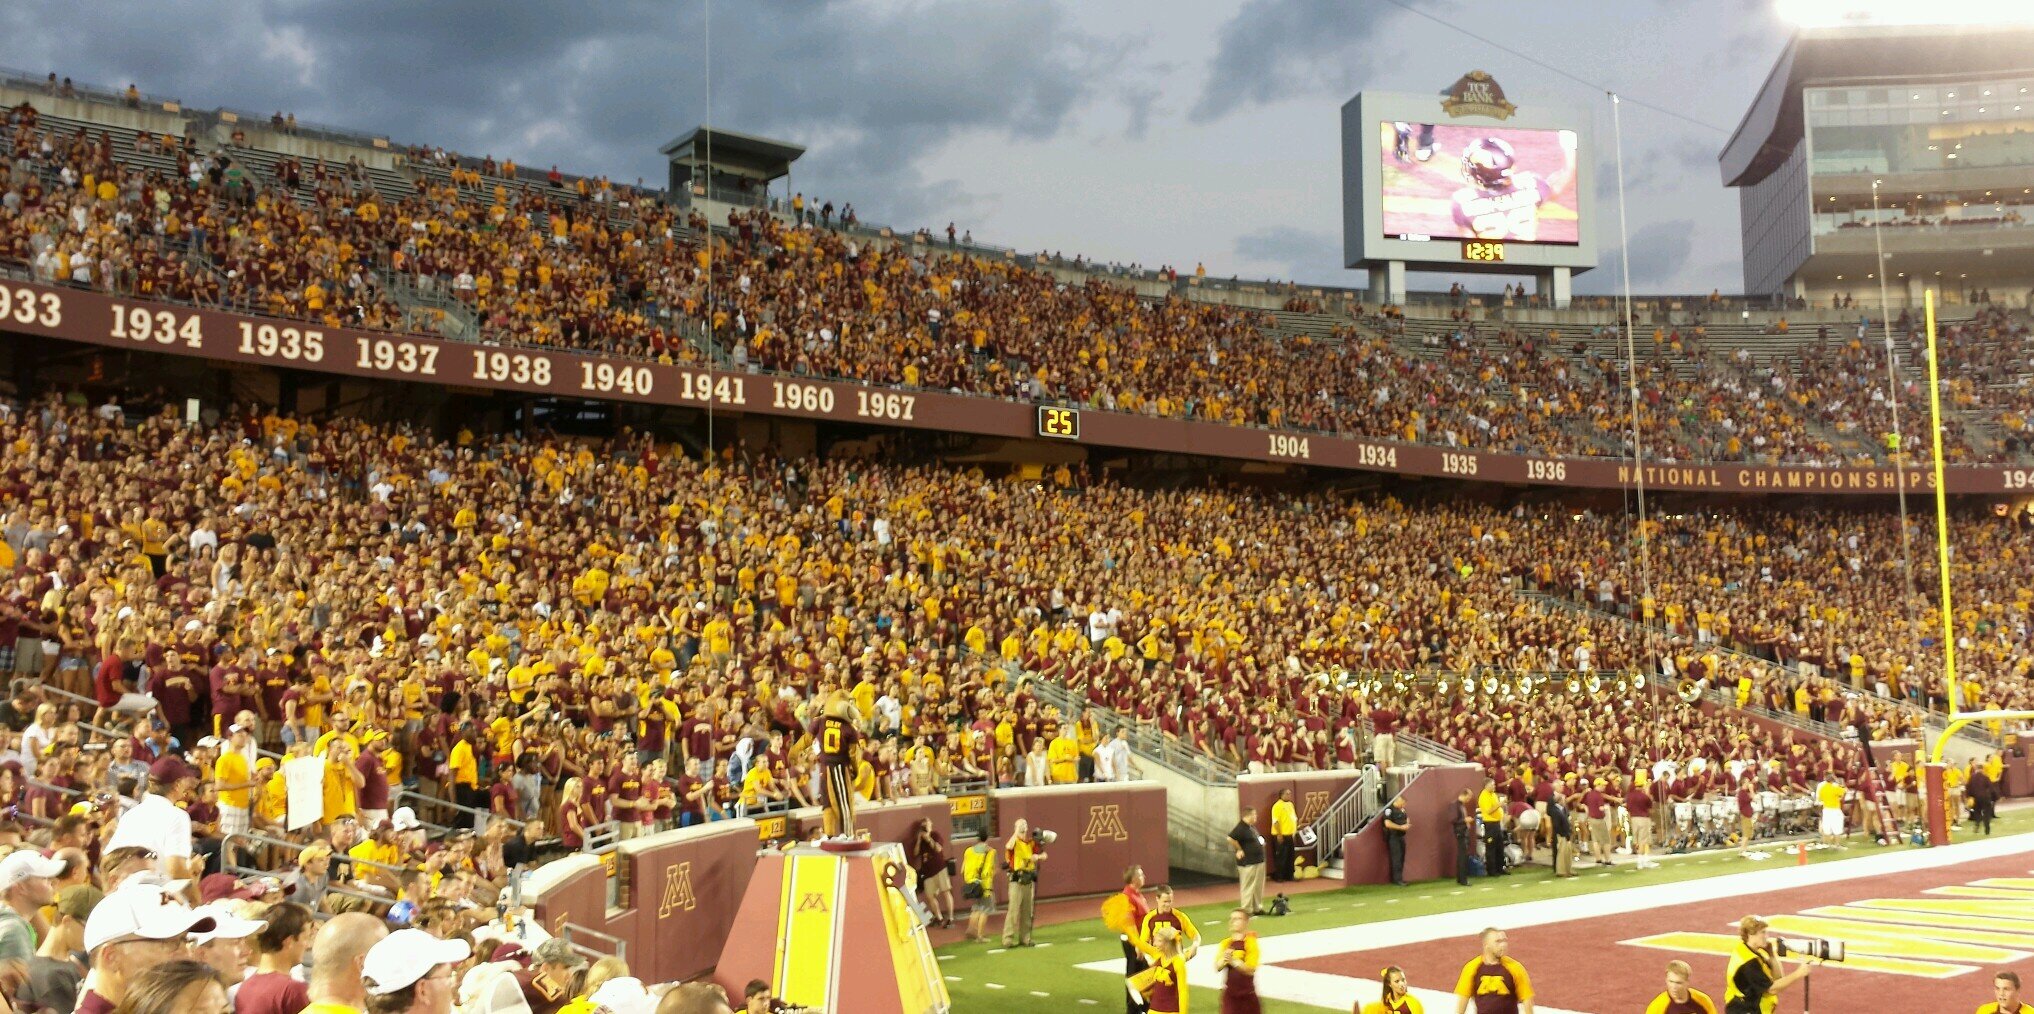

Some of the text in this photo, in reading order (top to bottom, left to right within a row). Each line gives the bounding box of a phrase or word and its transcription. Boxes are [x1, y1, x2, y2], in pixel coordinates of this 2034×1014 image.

[1463, 91, 1494, 104] BANK
[1466, 242, 1504, 261] 12:39
[110, 304, 203, 349] 1934
[238, 321, 324, 362] 1935
[356, 337, 440, 375] 1937
[473, 350, 552, 386] 1938
[581, 361, 654, 396] 1940
[680, 372, 746, 405] 1941
[772, 381, 835, 413] 1960
[857, 390, 916, 421] 1967
[1046, 409, 1072, 436] 25
[1268, 433, 1310, 459] 1904
[1358, 443, 1397, 468] 1934
[1441, 452, 1478, 476] 1935
[1526, 459, 1566, 482] 1936
[1618, 465, 1938, 489] NATIONAL CHAMPIONSHIPS
[823, 727, 841, 754] 0
[1081, 804, 1128, 845] M
[658, 861, 696, 919] M
[797, 892, 829, 913] M
[1476, 975, 1510, 996] M
